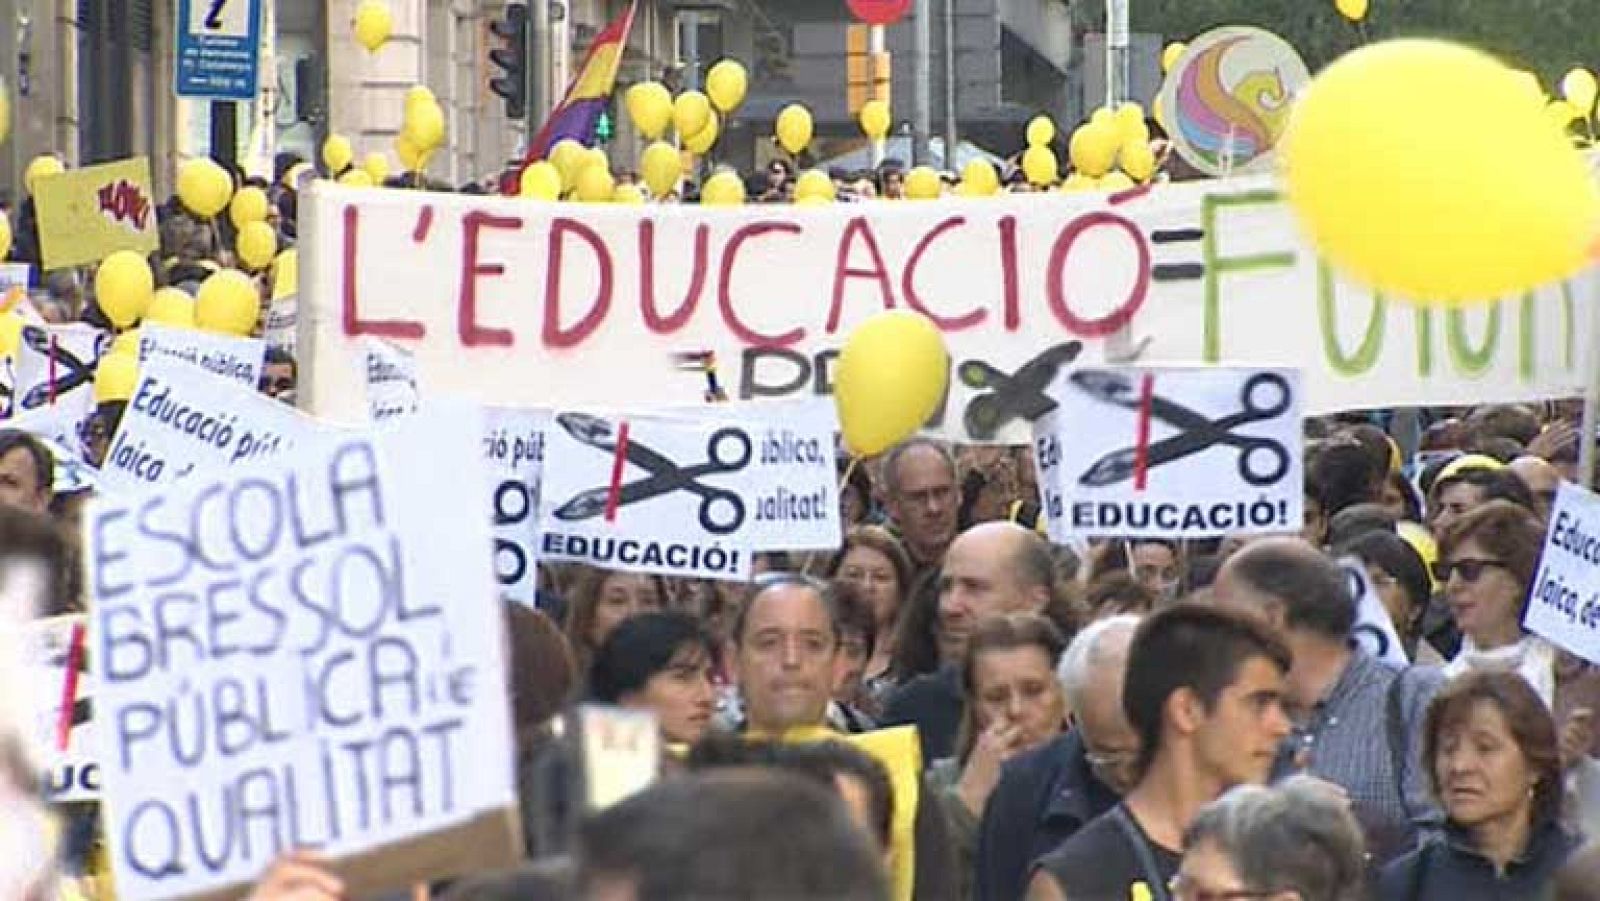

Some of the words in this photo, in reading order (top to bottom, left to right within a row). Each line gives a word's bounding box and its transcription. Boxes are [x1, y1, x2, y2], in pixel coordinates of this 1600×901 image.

[342, 185, 1151, 348] L'EDUCACIÓ
[133, 376, 234, 448] Educació
[95, 440, 385, 600] ESCOLA
[543, 532, 740, 573] EDUCACIÓ!
[1072, 494, 1288, 530] EDUCACIÓ!
[102, 533, 444, 682] BRESSOL
[117, 635, 419, 773] PÚBLICA
[124, 716, 465, 880] QUALITAT
